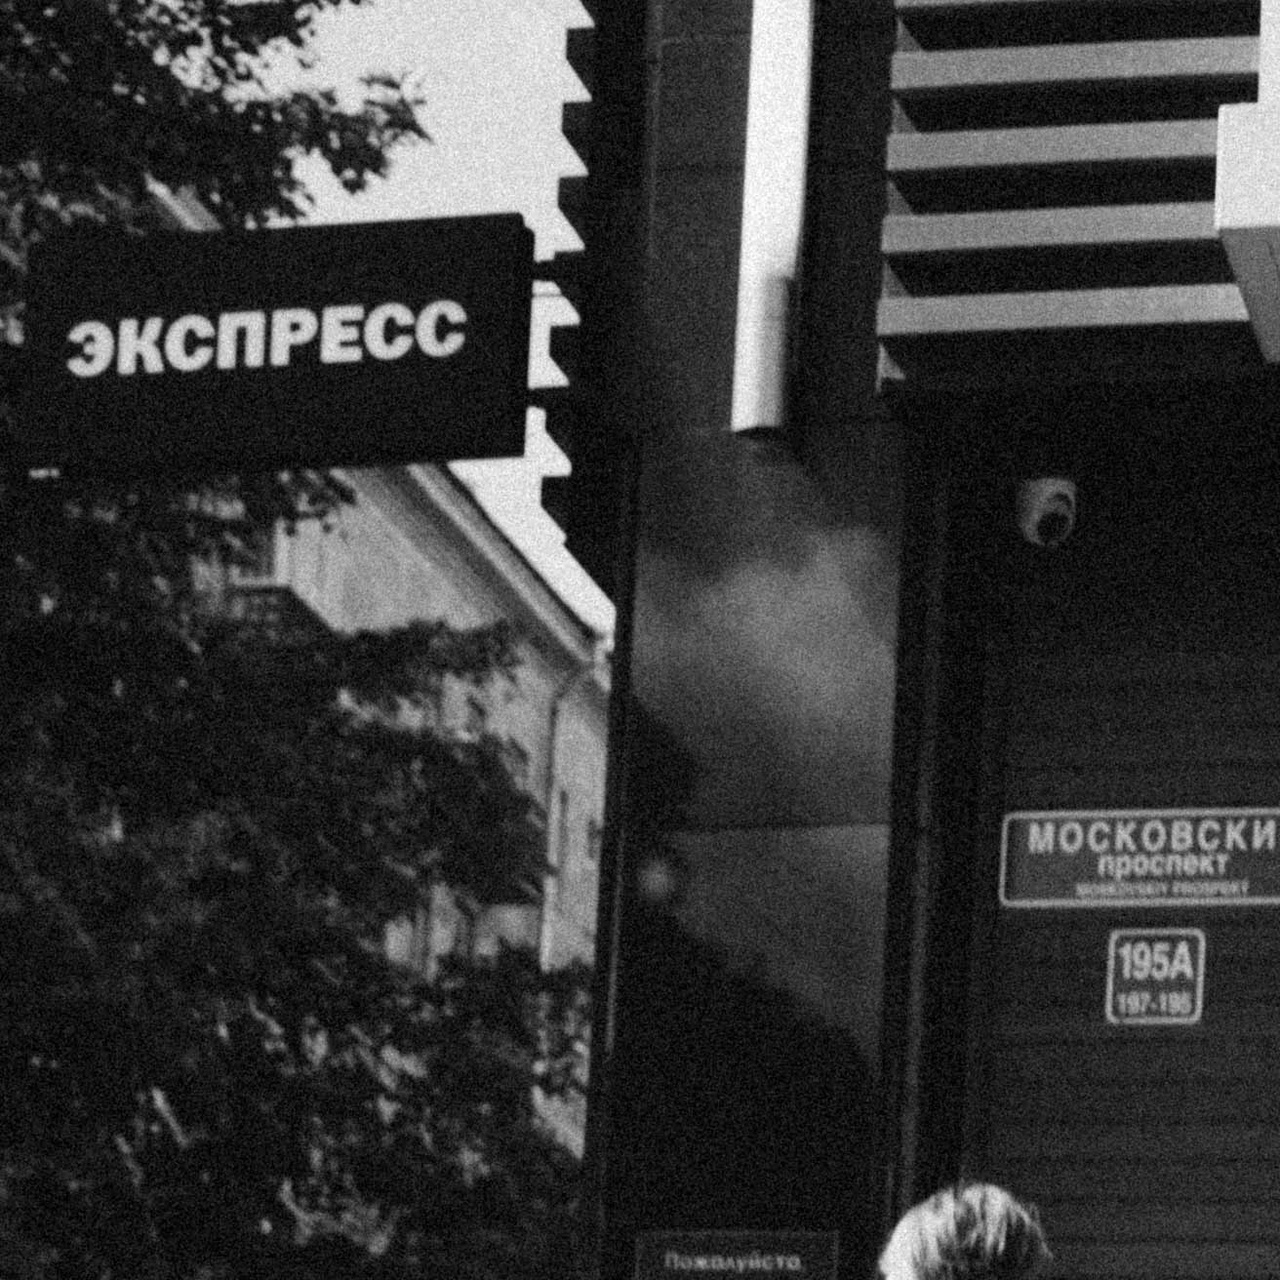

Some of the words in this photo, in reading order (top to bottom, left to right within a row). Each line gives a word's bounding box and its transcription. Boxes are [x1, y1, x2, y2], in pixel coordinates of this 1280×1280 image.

[66, 299, 469, 378] ЭКСПРЕСС
[1096, 853, 1230, 879] проспект
[1117, 939, 1195, 981] 195А
